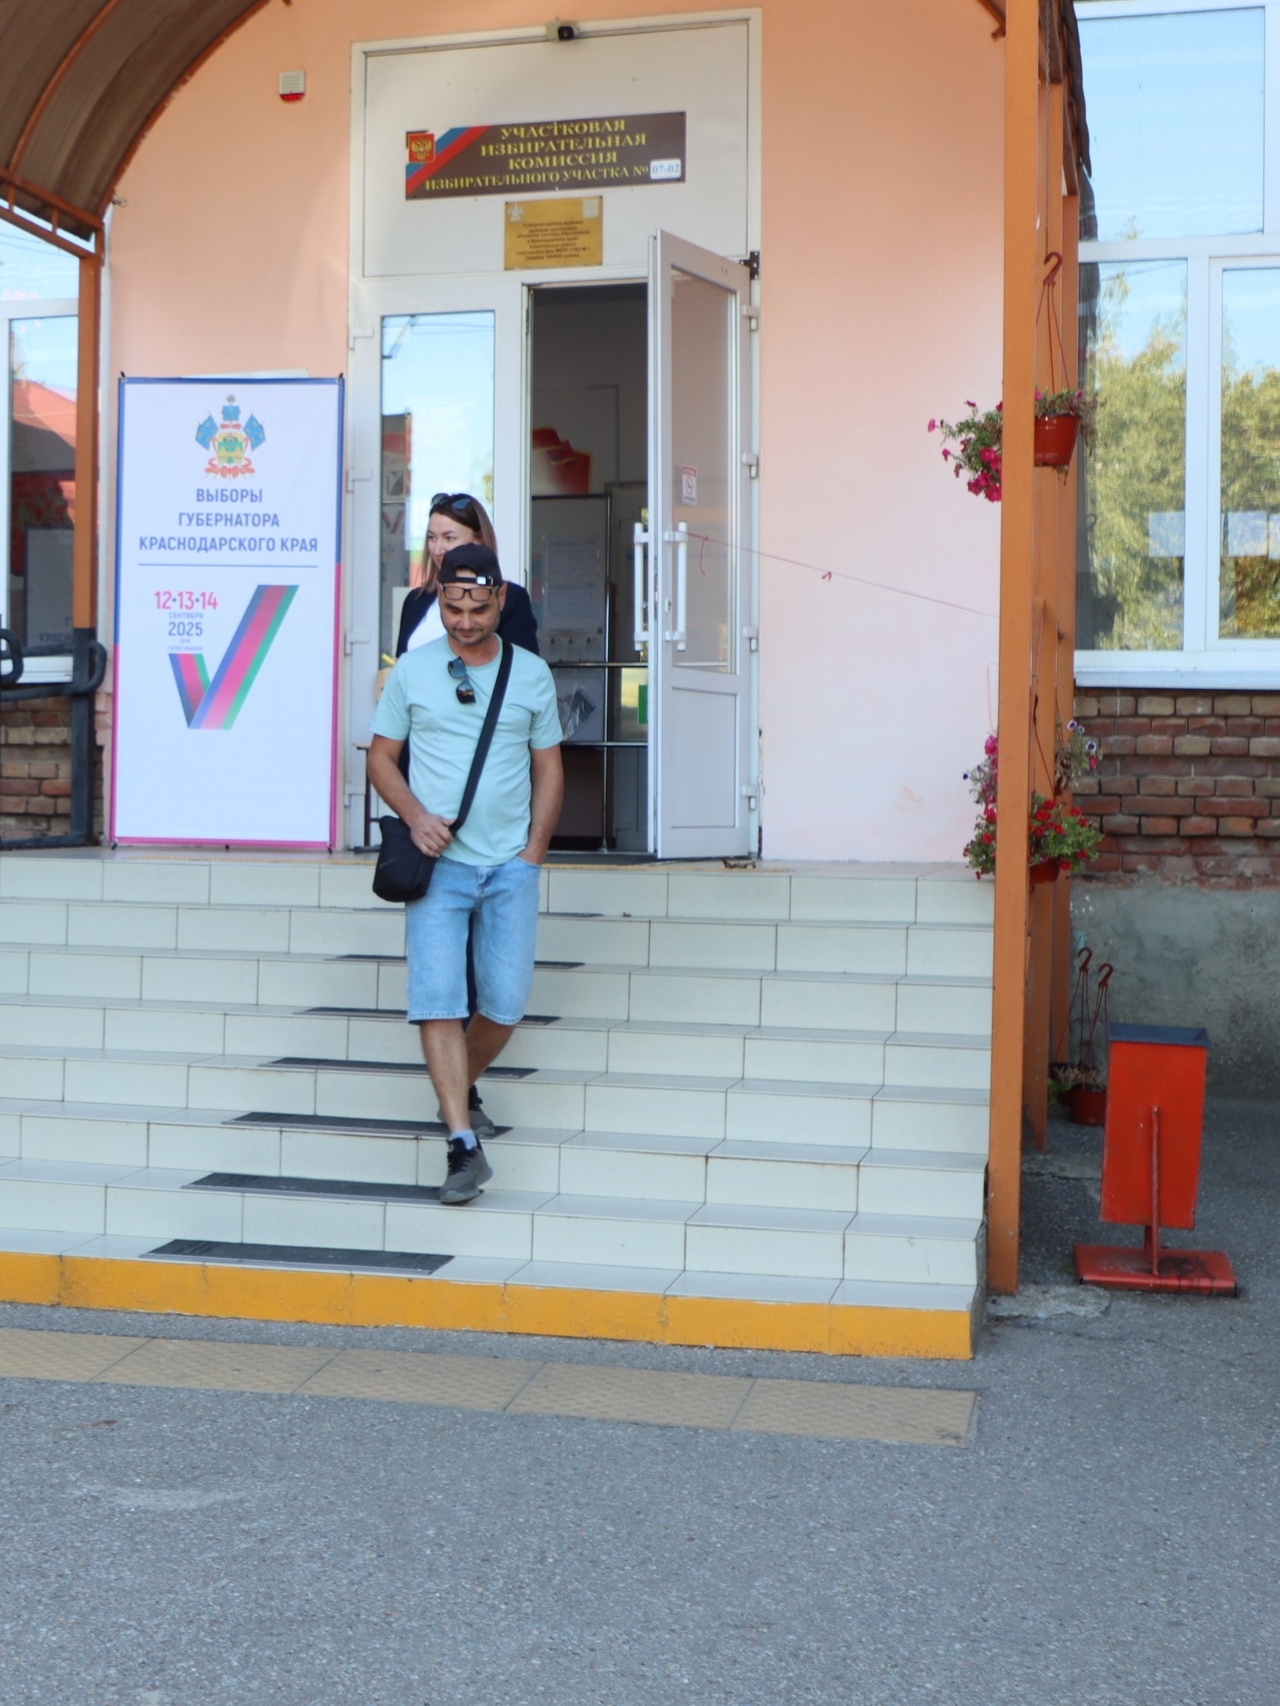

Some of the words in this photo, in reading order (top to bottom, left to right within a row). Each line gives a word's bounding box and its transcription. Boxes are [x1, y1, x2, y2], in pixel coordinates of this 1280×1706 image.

[501, 119, 626, 140] УЧАСТКОВАЯ
[481, 133, 647, 156] ИЗБИРАТЕЛЬНАЯ
[509, 151, 618, 170] КОМИССИЯ
[425, 171, 560, 191] ИЗБИРАТЕЛЬНОГО
[562, 165, 629, 182] УЧАСТКА
[196, 488, 263, 503] ВЫБОРЫ
[178, 512, 280, 528] ГУБЕРНАТОРА
[139, 536, 276, 553] КРАСНОДАРСКОГО
[280, 538, 318, 552] КРАЯ
[169, 612, 204, 620] СЕНТЯБРЯ
[168, 621, 203, 637] 2025
